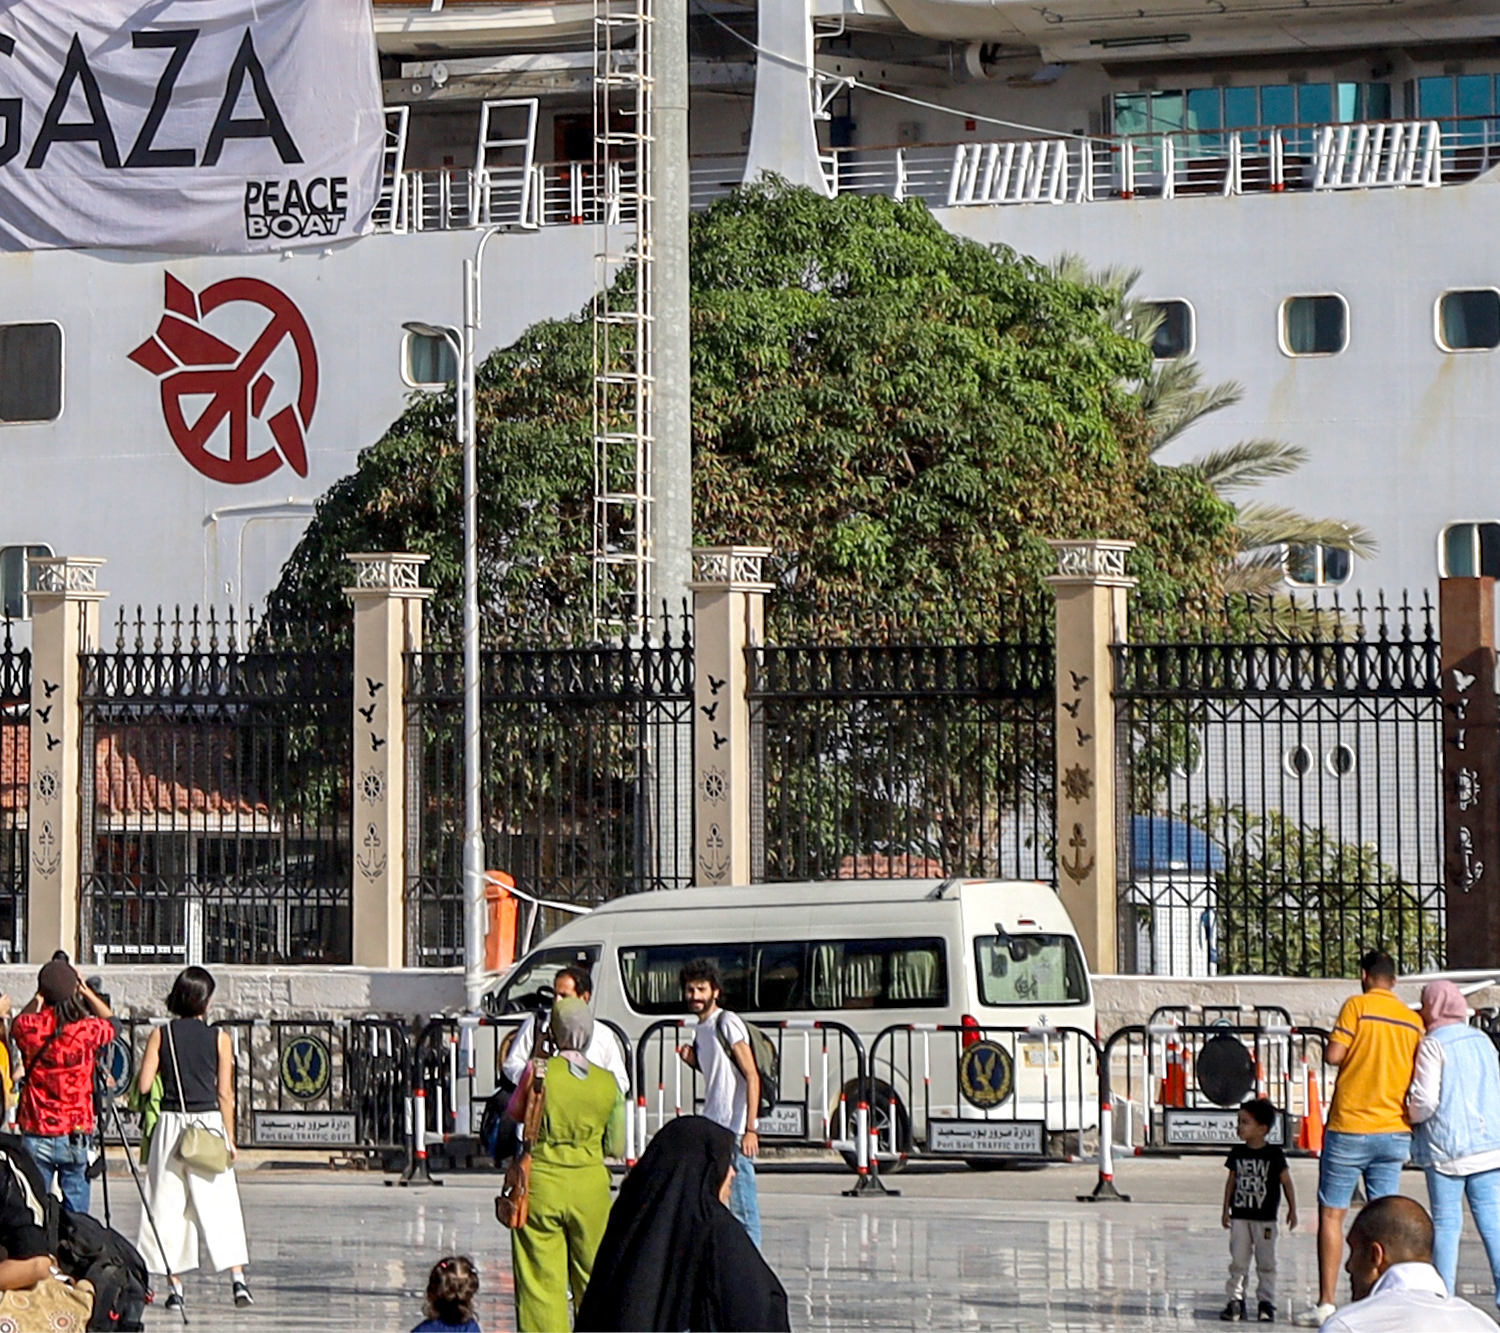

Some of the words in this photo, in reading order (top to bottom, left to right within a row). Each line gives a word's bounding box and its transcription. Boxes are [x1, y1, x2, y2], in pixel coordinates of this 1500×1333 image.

[244, 177, 348, 216] PEACE
[246, 213, 347, 240] BOAT
[1235, 1159, 1270, 1176] NEW
[1234, 1189, 1268, 1209] CITY
